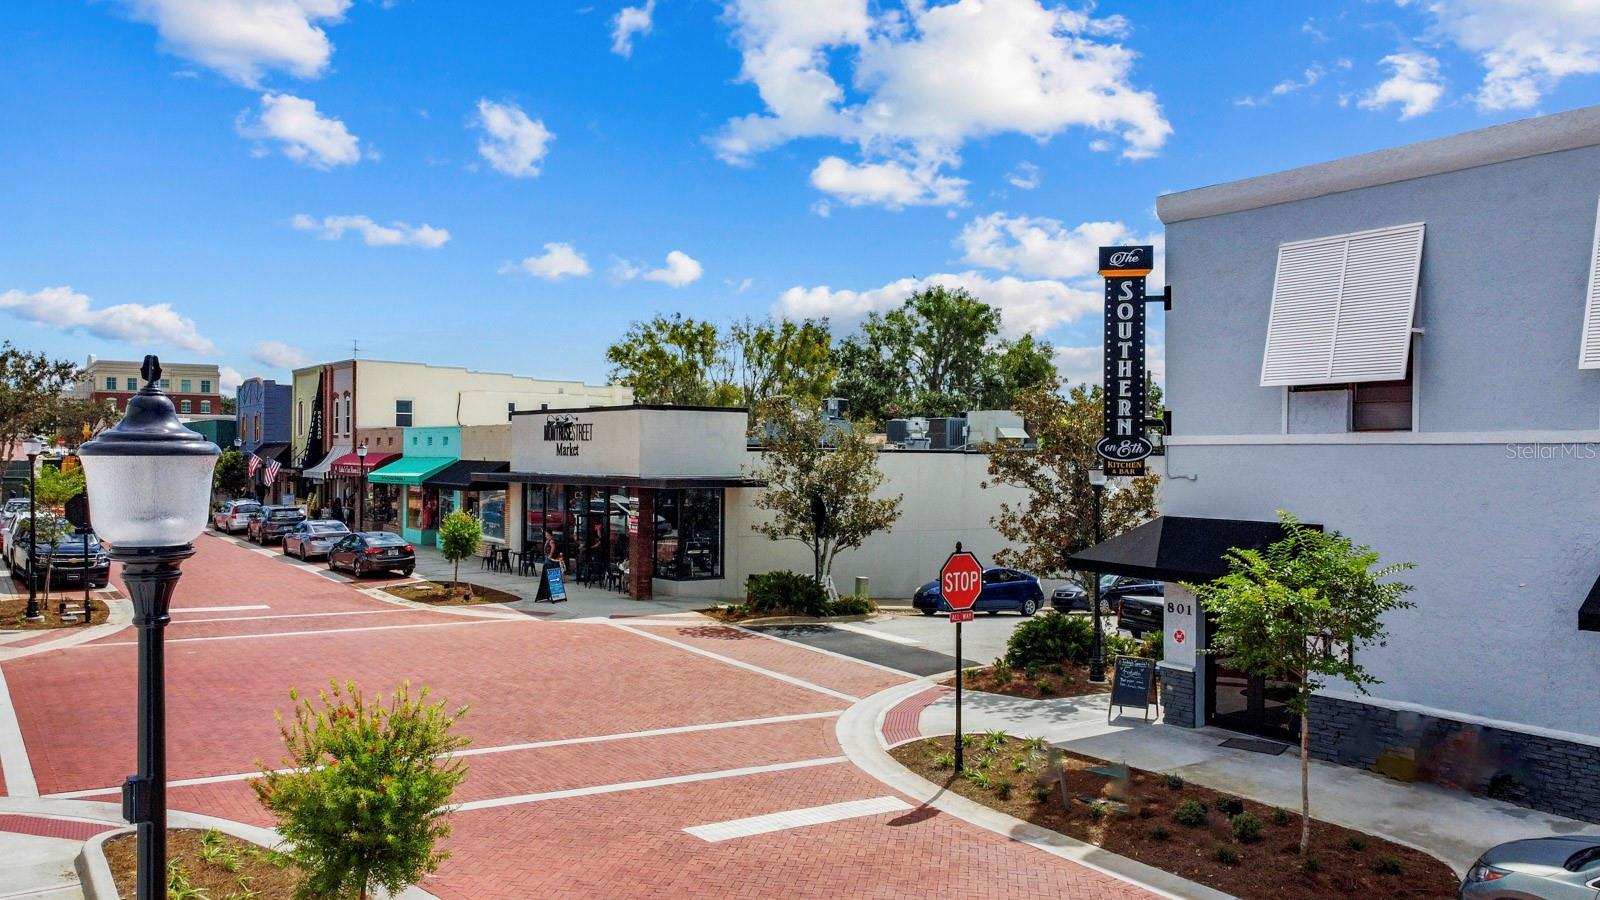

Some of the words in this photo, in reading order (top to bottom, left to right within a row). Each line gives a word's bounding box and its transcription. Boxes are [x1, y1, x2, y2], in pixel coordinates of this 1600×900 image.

[1109, 248, 1144, 267] The
[1116, 280, 1134, 436] SOUTHERN
[556, 442, 579, 456] Market
[1104, 444, 1117, 452] on
[1116, 439, 1144, 457] 8th
[1107, 461, 1142, 469] KITCHEN
[945, 571, 979, 593] STOP
[951, 613, 961, 621] ALL
[1167, 602, 1192, 616] 801
